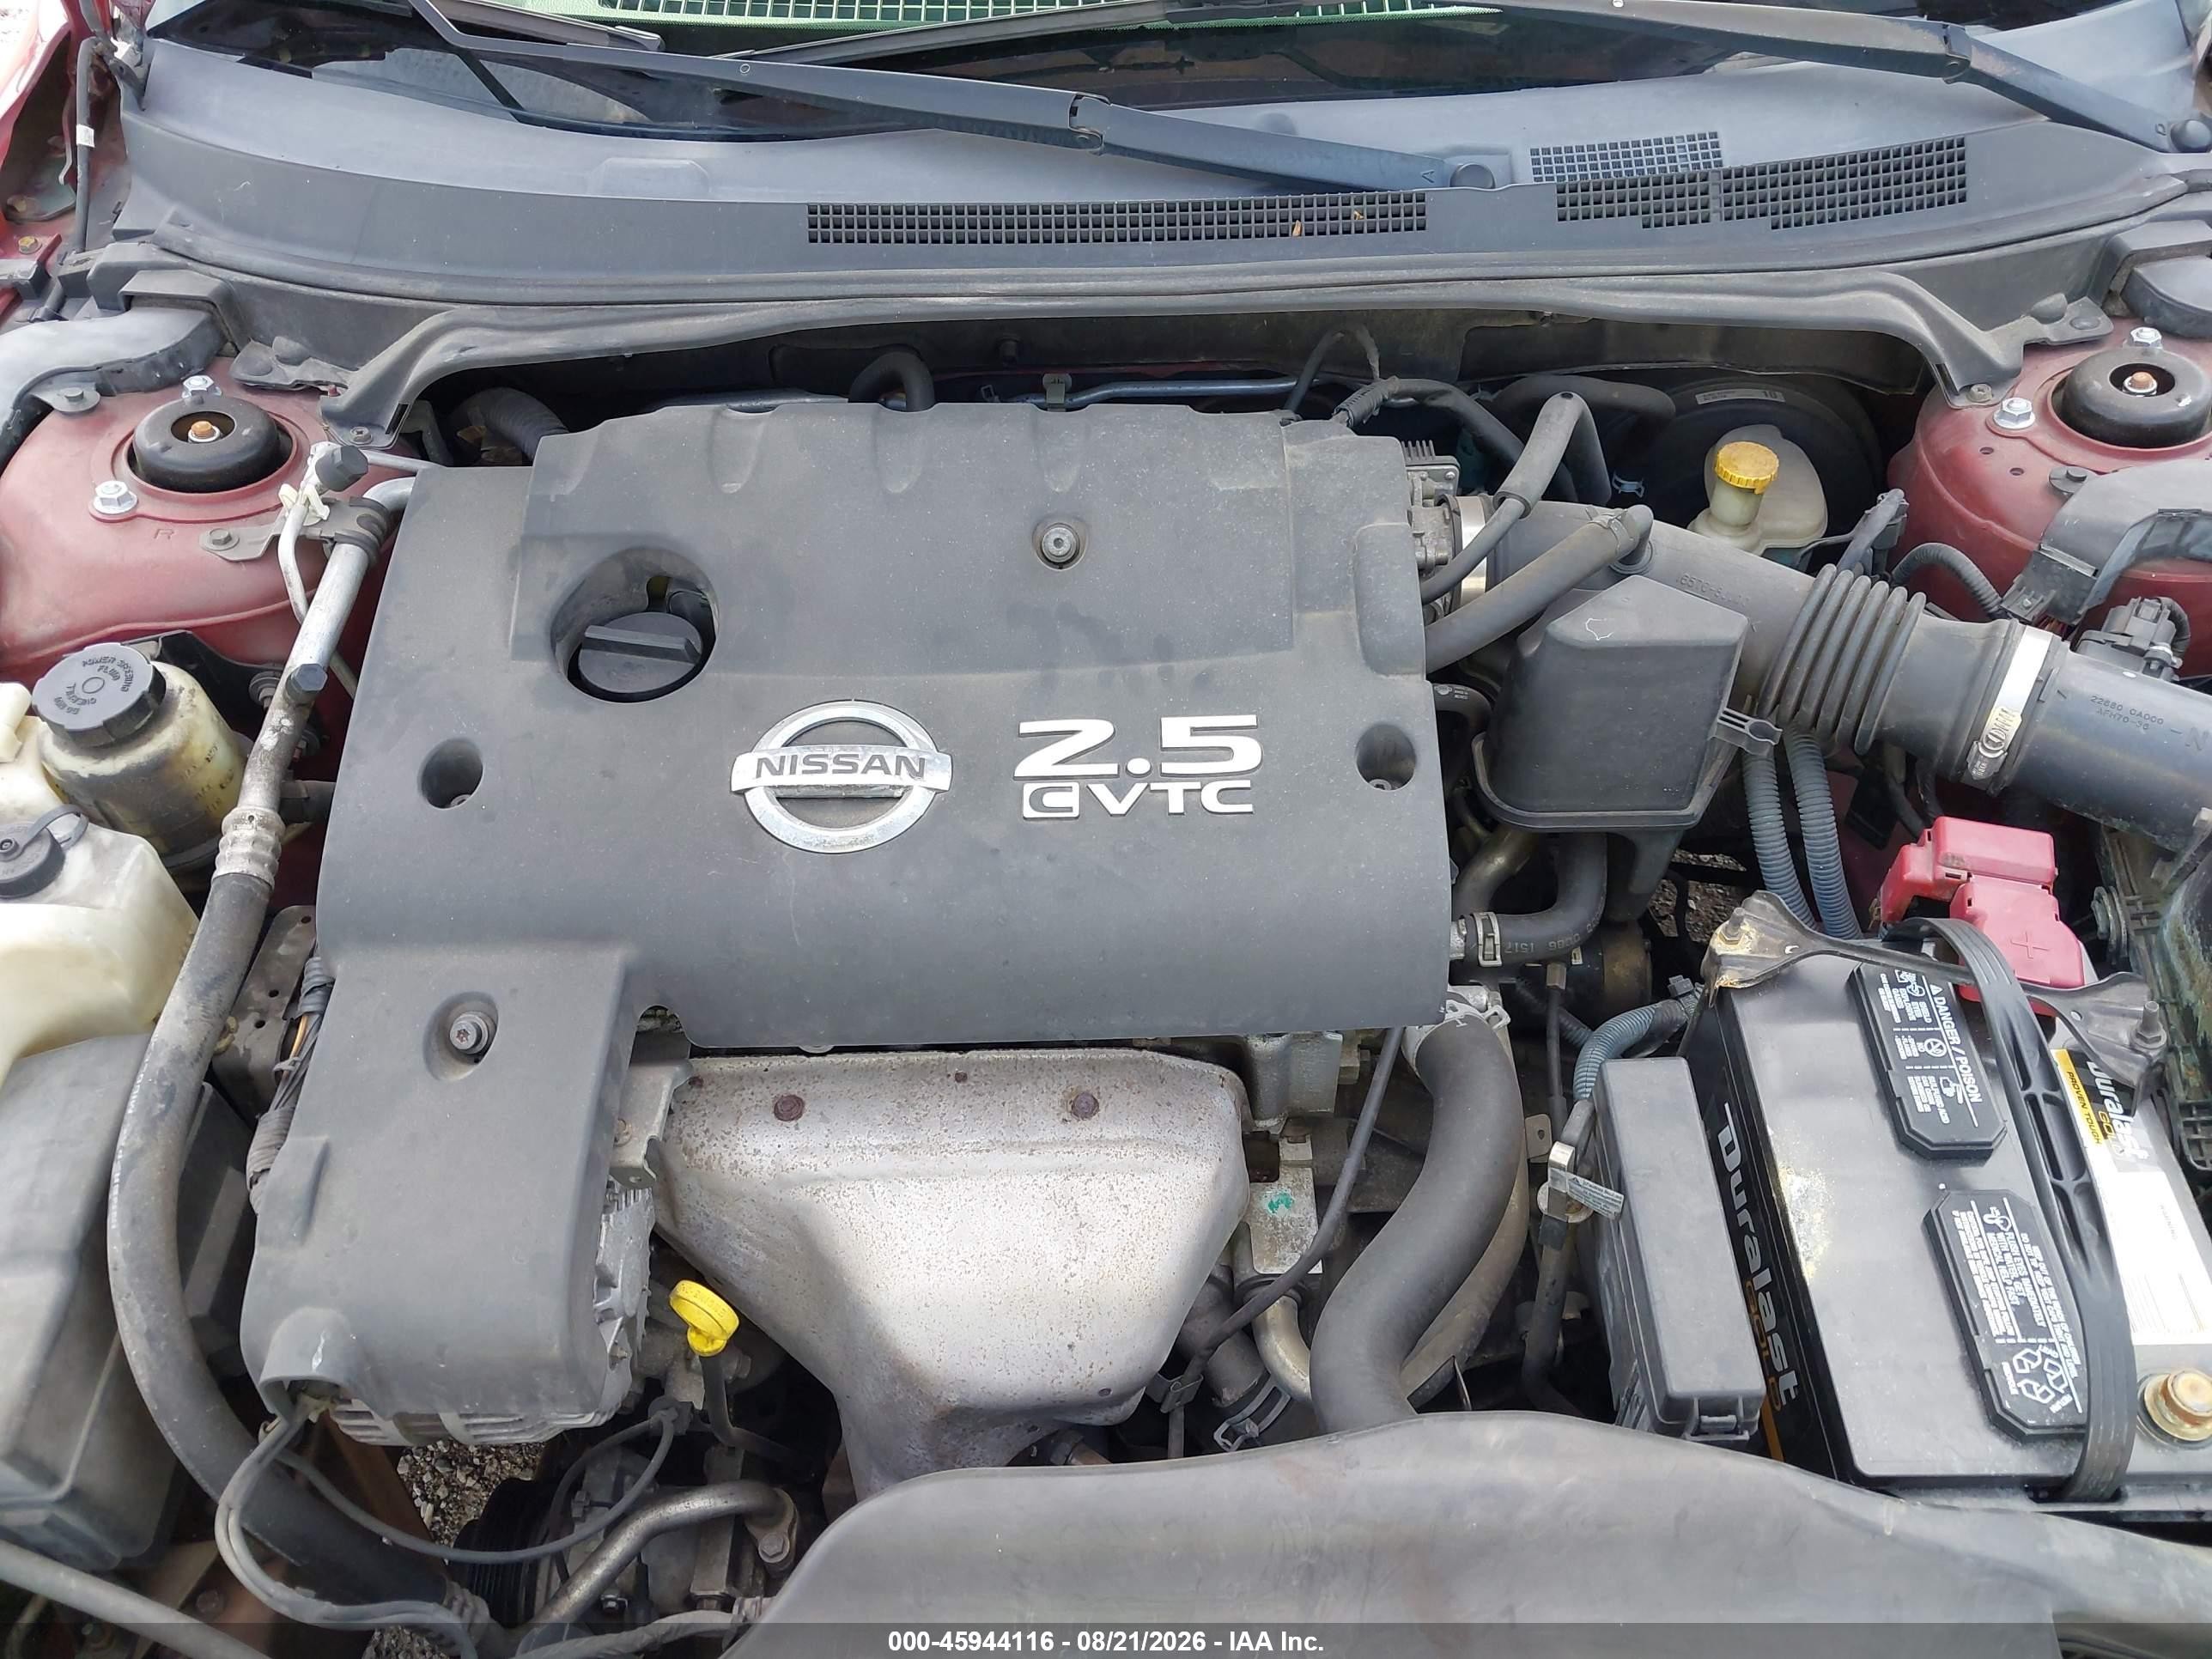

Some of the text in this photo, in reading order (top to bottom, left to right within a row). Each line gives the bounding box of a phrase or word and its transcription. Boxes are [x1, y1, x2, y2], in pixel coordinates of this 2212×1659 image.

[82, 656, 116, 666] POWER
[1014, 714, 1263, 778] 2.5
[756, 753, 927, 780] NISSAN
[1022, 780, 1254, 819] CVTC
[1891, 988, 1905, 1009] GASES
[1898, 988, 1917, 1021] EXPLOSIVE
[1910, 1000, 1923, 1018] EYES
[1917, 1000, 1932, 1023] SHIELD
[1915, 1041, 1925, 1052] NO
[1932, 995, 1961, 1044] DANGER
[1954, 1055, 1983, 1103] POISON
[1937, 1107, 1950, 1124] ACID
[2066, 1071, 2102, 1145] PROVEN TOUGH
[2019, 1231, 2030, 1243] DO
[1717, 1102, 1800, 1407] Duralast
[1985, 1233, 2021, 1305] MEDICAL HELP FAST
[1994, 1232, 2012, 1256] WITH
[2012, 1280, 2026, 1297] GET
[2037, 1261, 2049, 1275] OUT
[2003, 1231, 2046, 1327] FLUSH EYES IMMEDIATELY
[1744, 1279, 1782, 1412] GOLD
